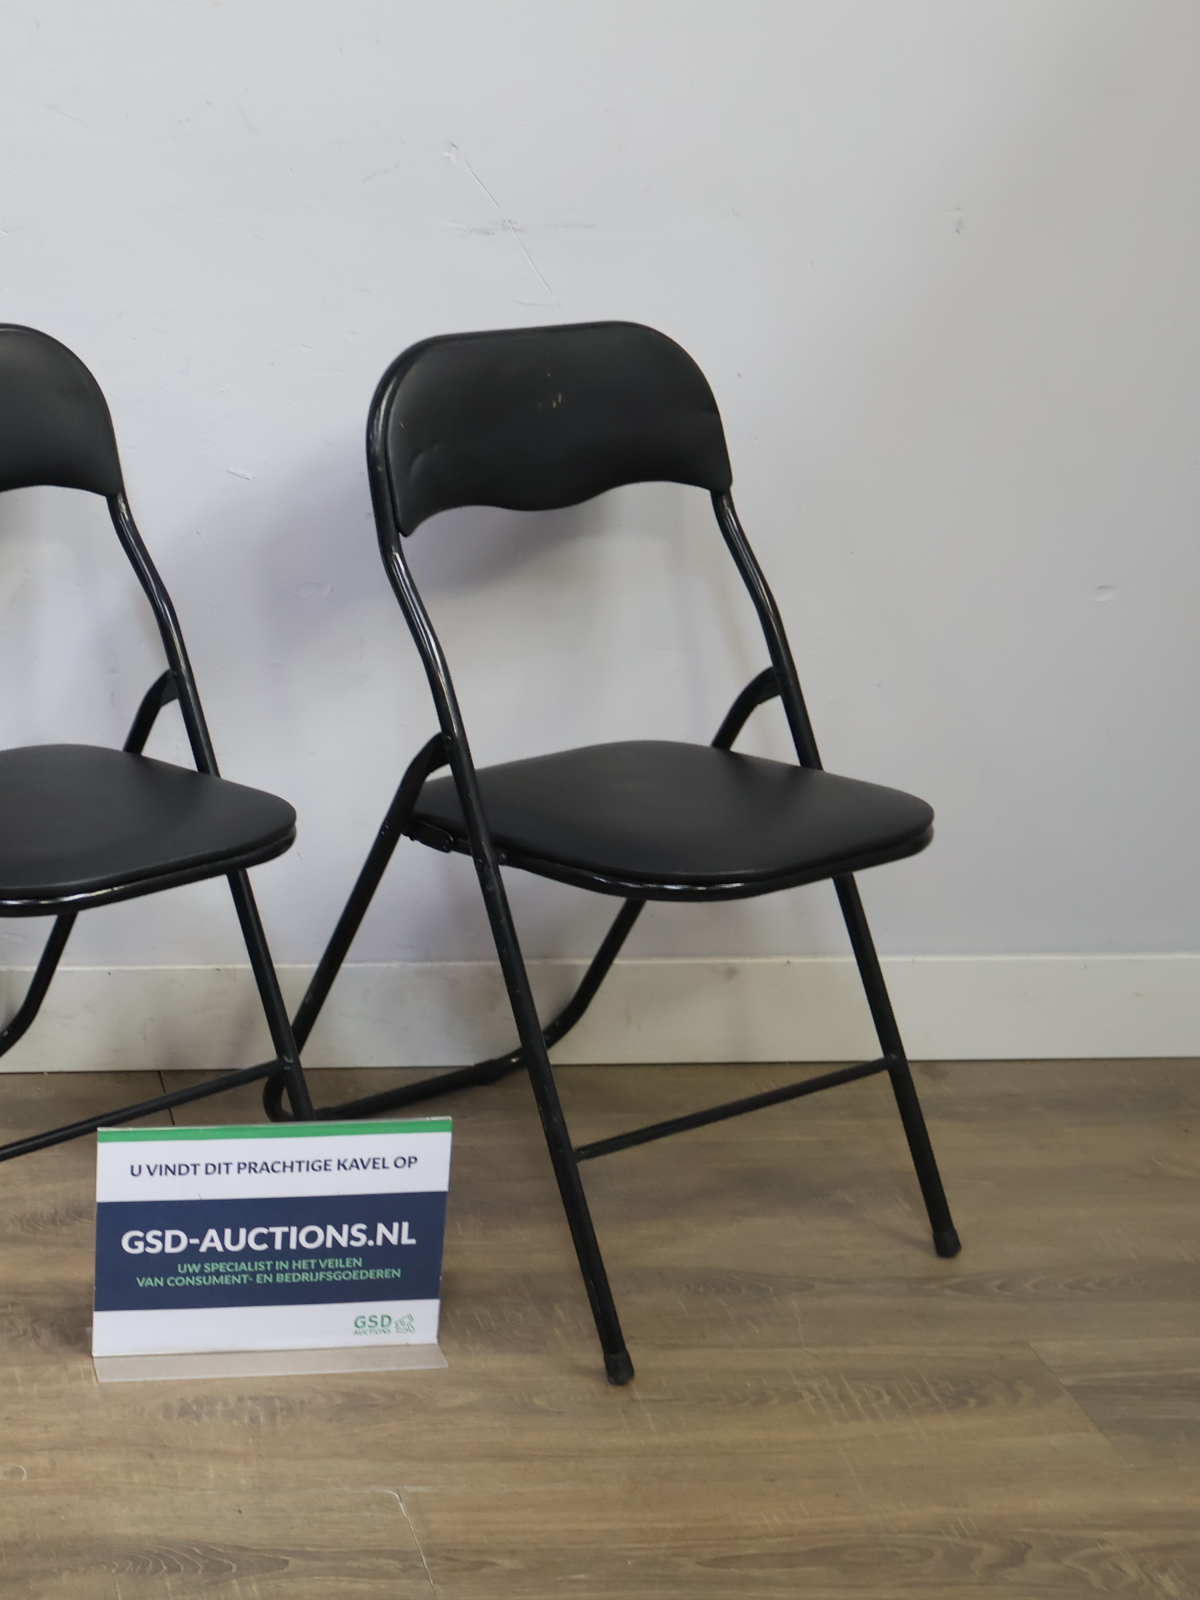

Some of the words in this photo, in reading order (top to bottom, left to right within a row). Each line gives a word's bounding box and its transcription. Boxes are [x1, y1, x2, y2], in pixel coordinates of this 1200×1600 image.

[130, 1164, 142, 1177] U
[146, 1163, 200, 1177] VINDT
[204, 1162, 233, 1175] DIT
[237, 1159, 333, 1174] PRACHTIGE
[337, 1157, 390, 1172] KAVEL
[393, 1155, 418, 1169] OP
[121, 1221, 417, 1254] GSD-AUCTIONS.NL
[177, 1263, 201, 1274] UW
[203, 1260, 274, 1273] SPECIALIST
[275, 1260, 290, 1271] IN
[292, 1259, 318, 1270] HET
[318, 1257, 362, 1269] VEILEN
[136, 1276, 164, 1288] VAN
[167, 1273, 253, 1287] CONSUMENT-
[256, 1273, 273, 1284] EN
[276, 1268, 401, 1283] BEDRIJFSGOEDEREN
[354, 1314, 392, 1329] GSD
